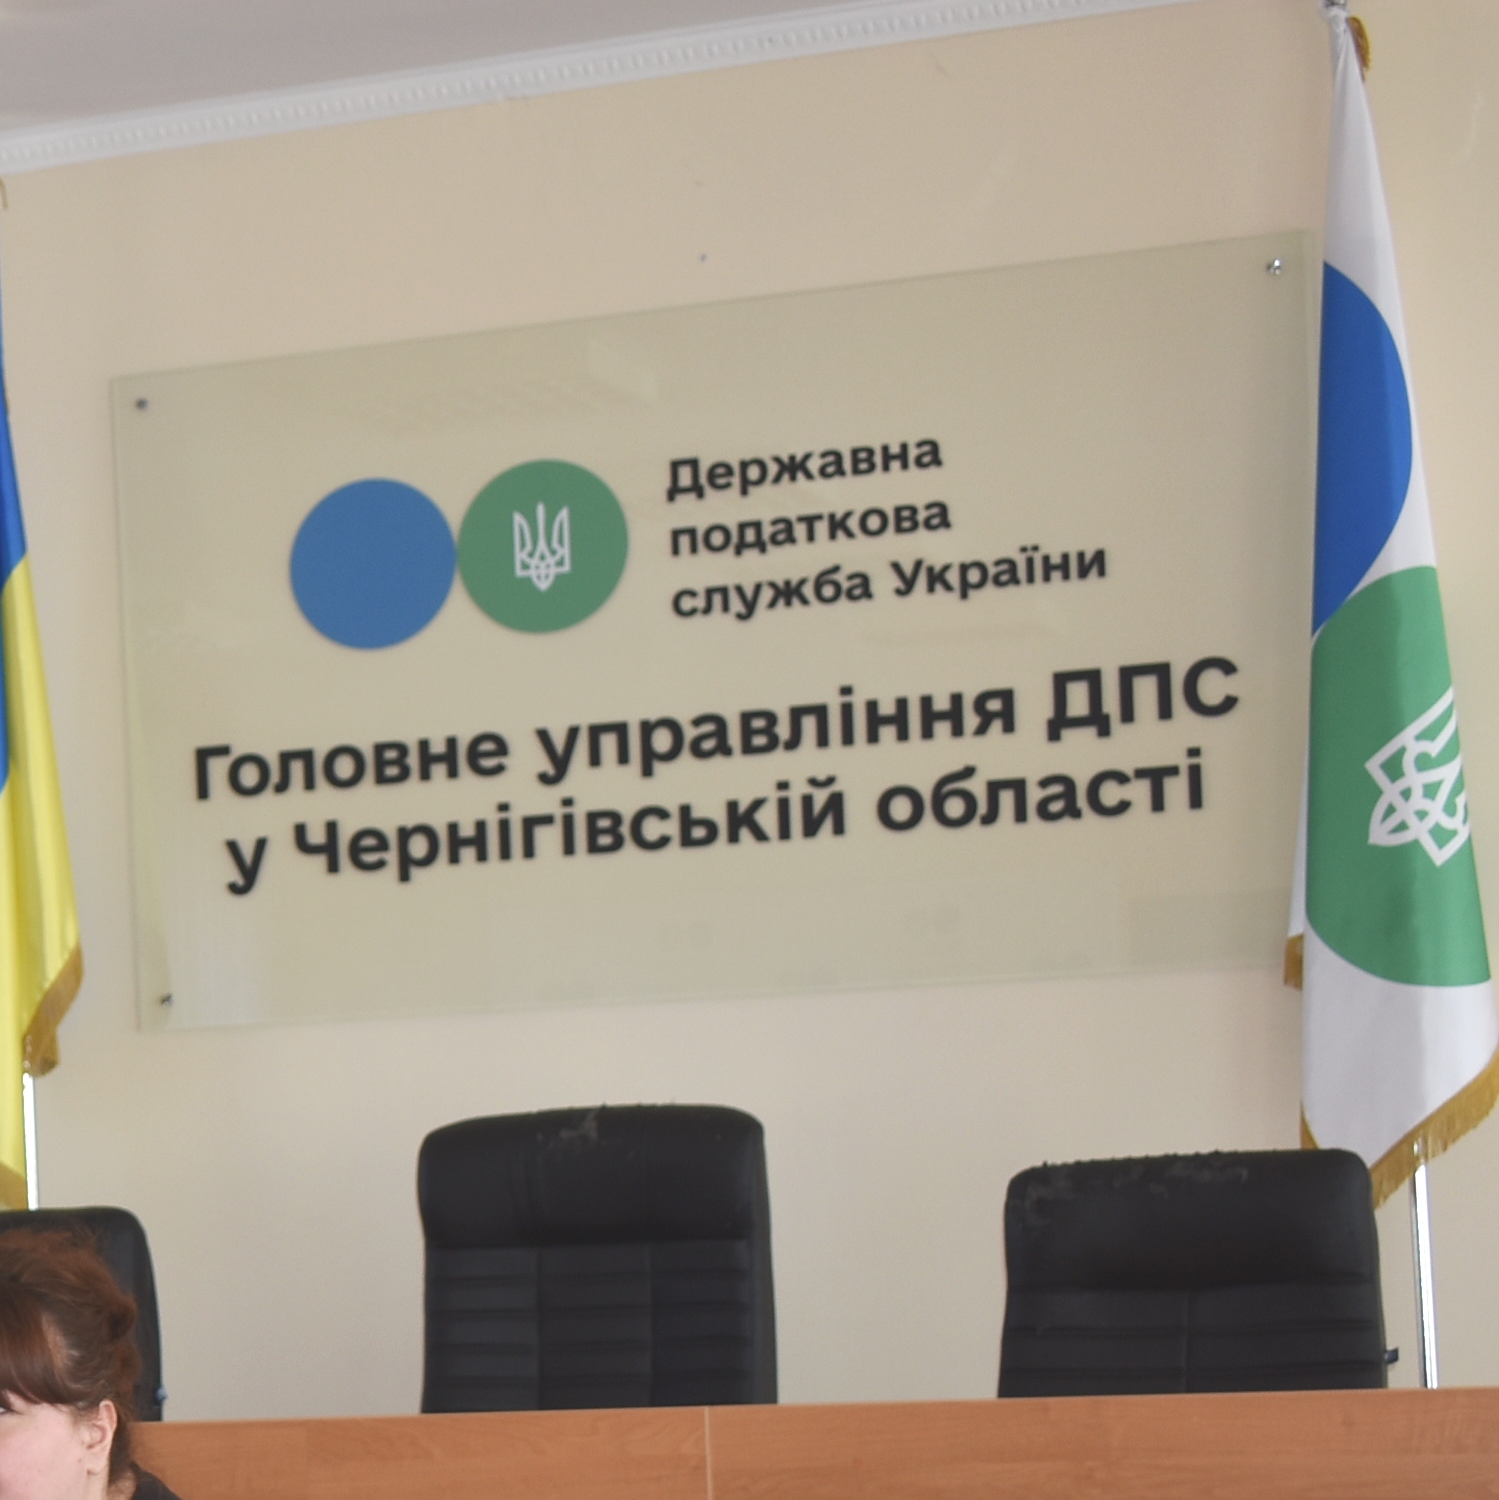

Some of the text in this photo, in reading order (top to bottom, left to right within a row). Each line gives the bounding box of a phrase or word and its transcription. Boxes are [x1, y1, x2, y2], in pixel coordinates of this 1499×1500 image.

[665, 437, 944, 504] Державна
[669, 500, 953, 558] податкова
[670, 543, 1108, 623] служба України
[193, 655, 1241, 802] Головне управління ДПС
[224, 745, 1205, 898] у Чернігівській області
